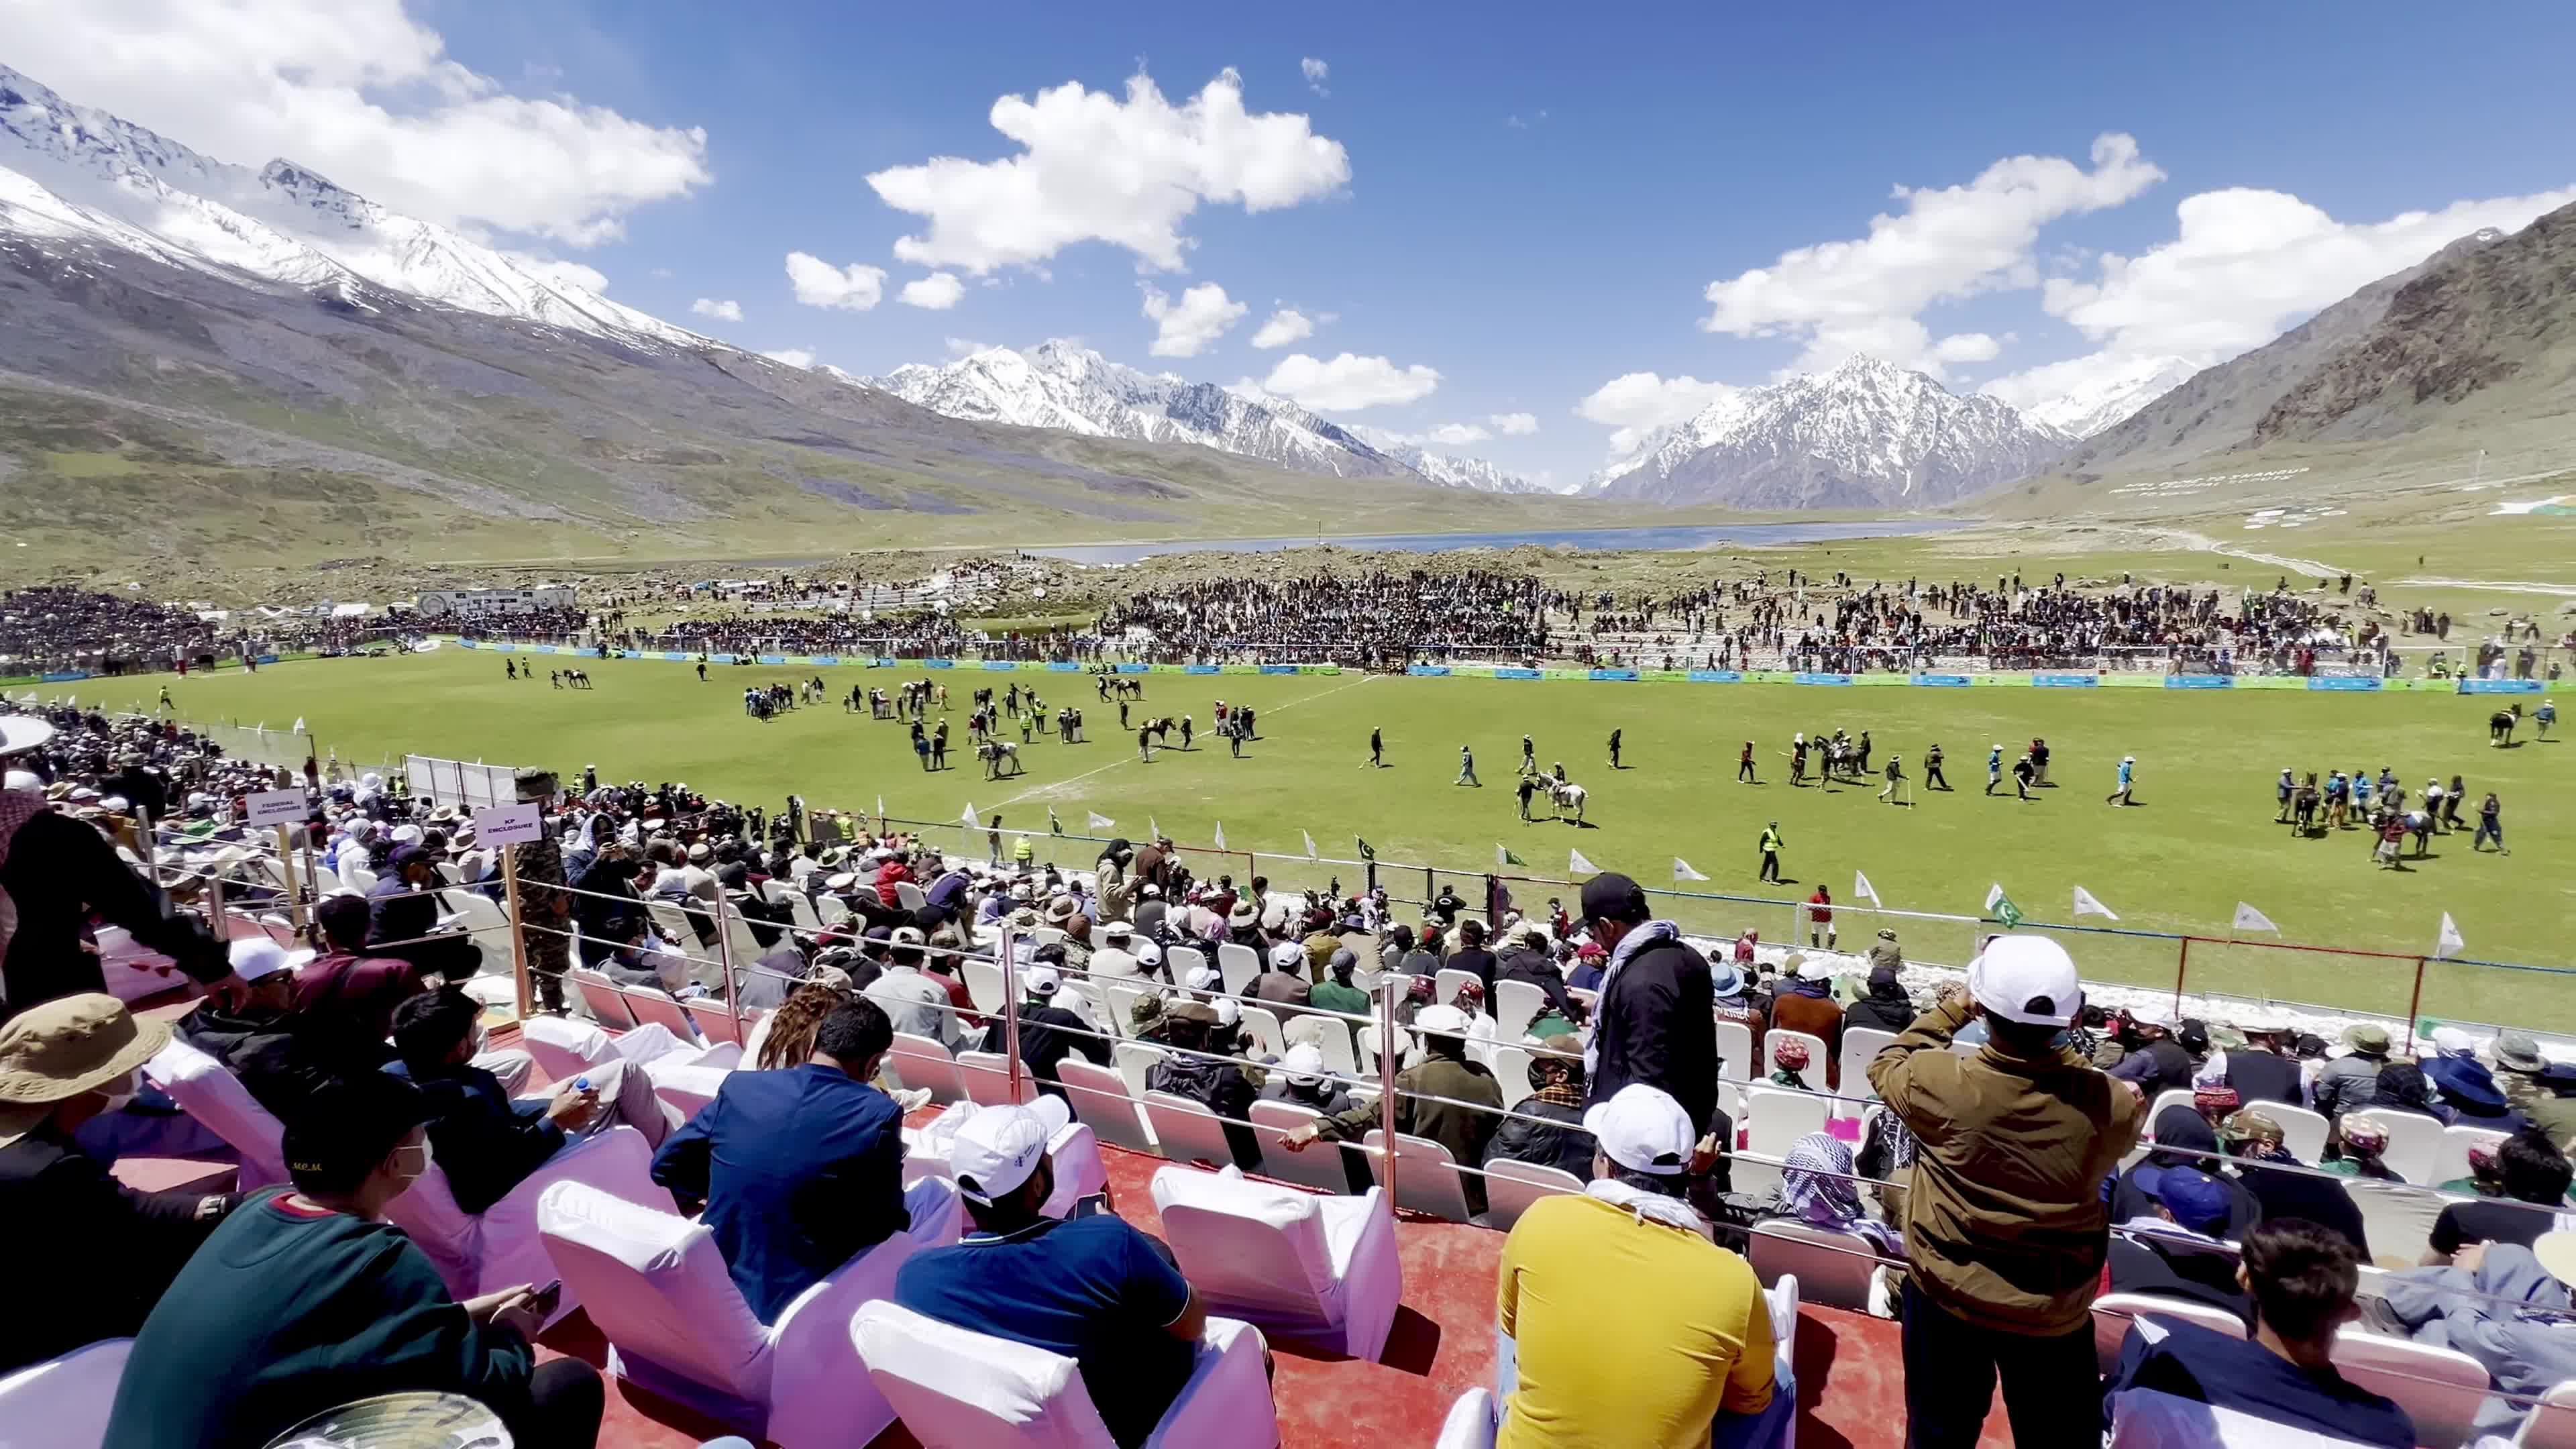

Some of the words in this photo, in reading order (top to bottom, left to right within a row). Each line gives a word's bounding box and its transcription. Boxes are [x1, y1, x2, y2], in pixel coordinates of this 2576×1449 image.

[2229, 468, 2310, 480] SHANDUR
[258, 805, 301, 814] ENCLOSURE
[488, 822, 533, 833] ENCLOSURE
